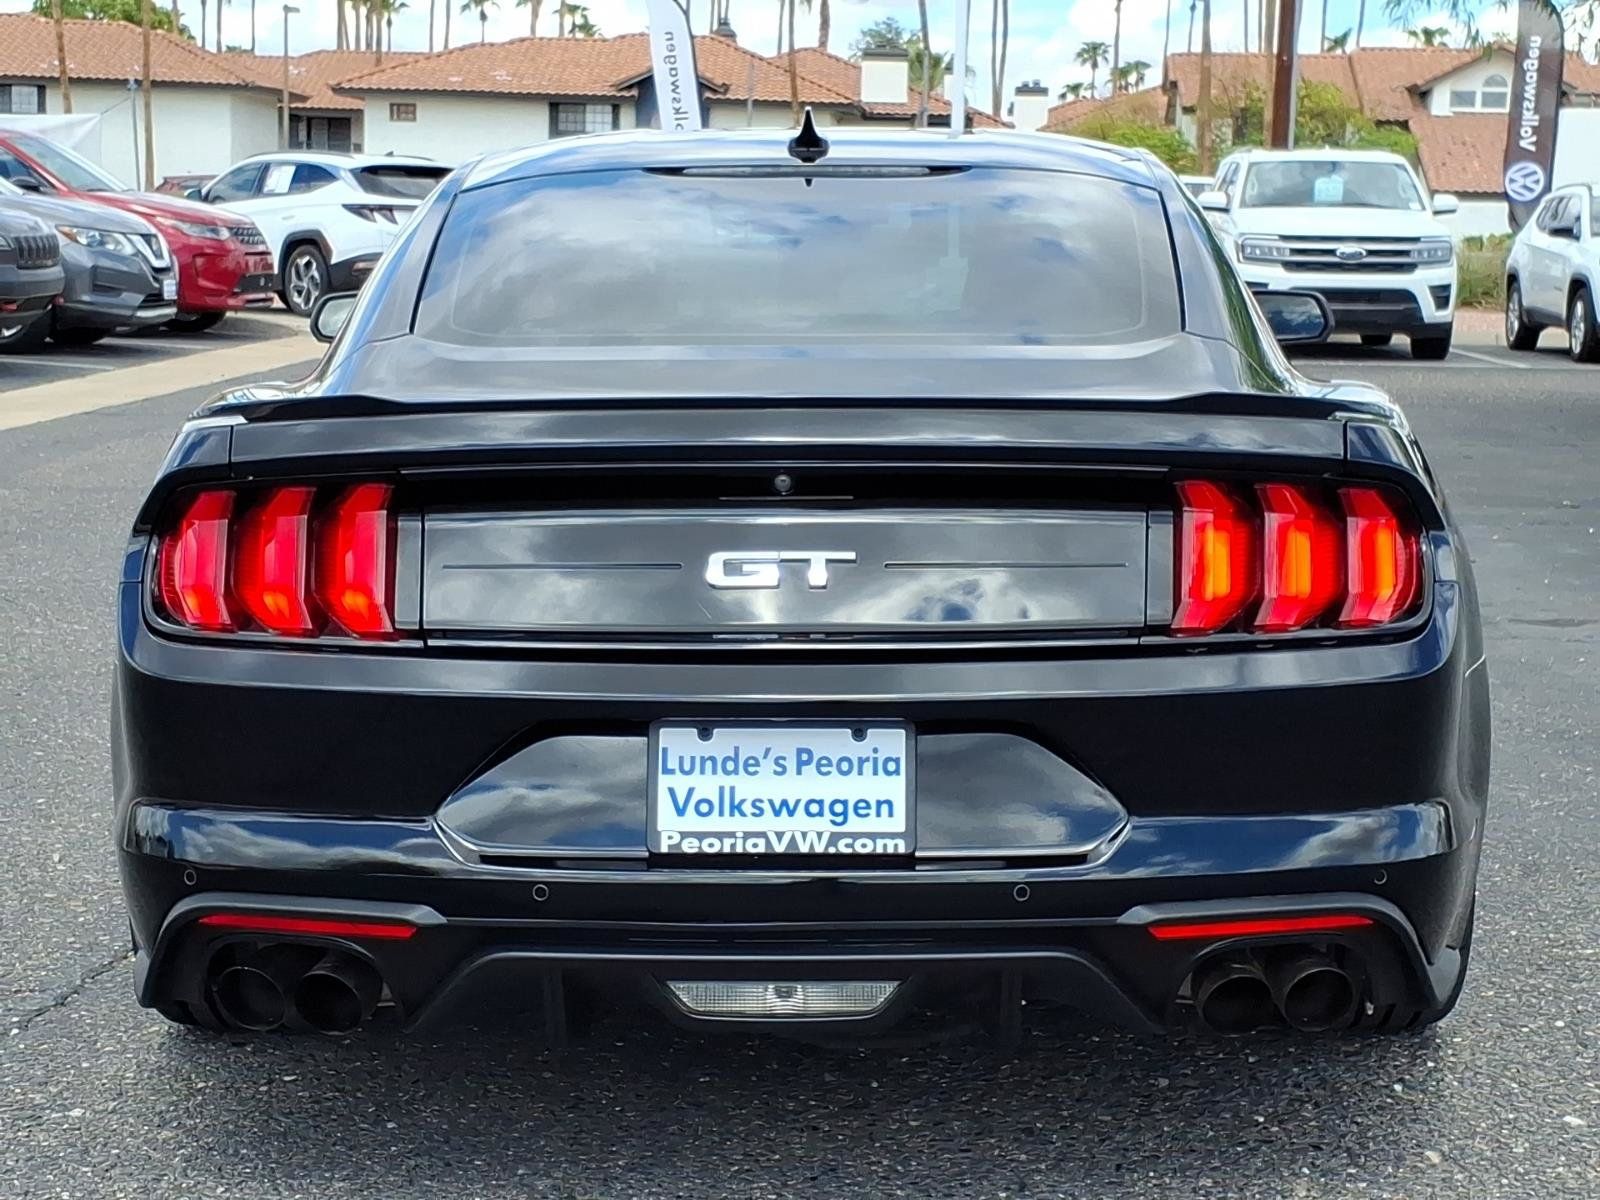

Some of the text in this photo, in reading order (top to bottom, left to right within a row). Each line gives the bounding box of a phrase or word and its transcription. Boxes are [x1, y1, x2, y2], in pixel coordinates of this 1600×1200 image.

[705, 551, 857, 588] GT
[661, 746, 900, 777] Lunde's Peoria
[668, 785, 894, 827] Volkswagen
[660, 830, 906, 854] PeoriaVW.com
